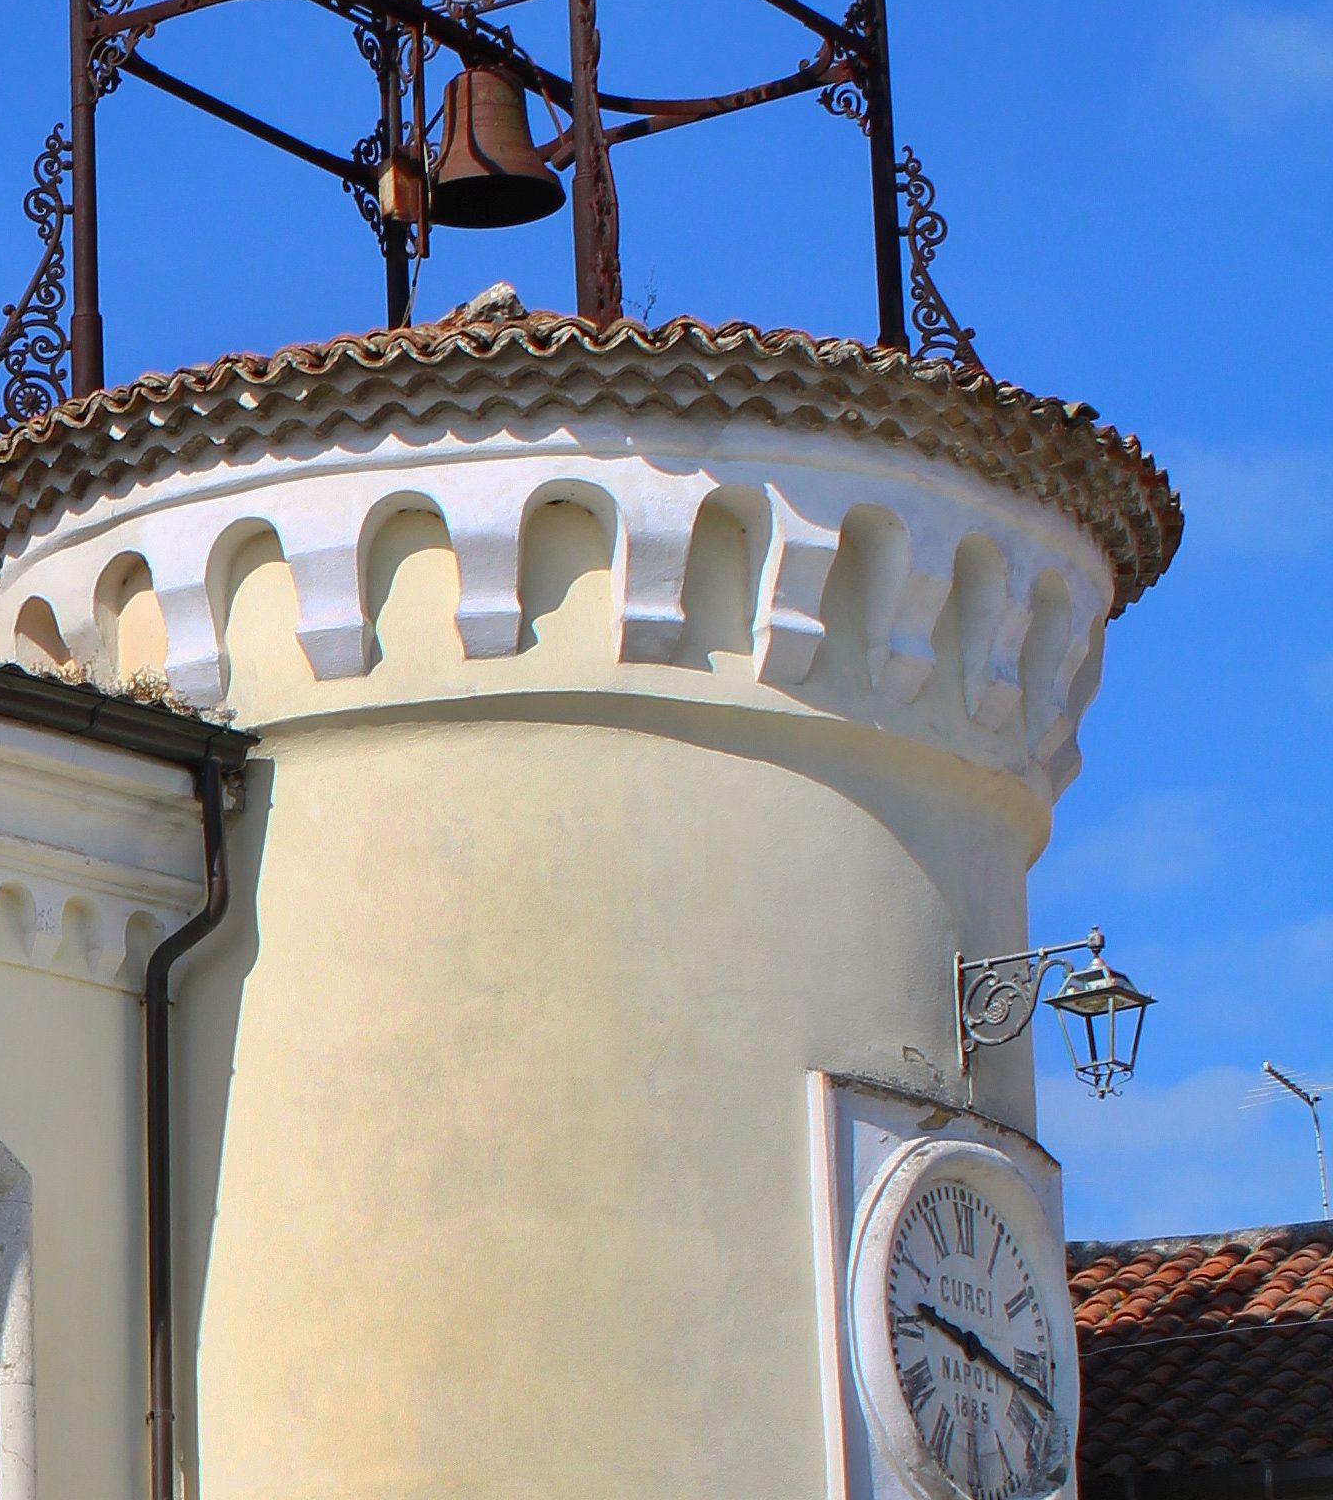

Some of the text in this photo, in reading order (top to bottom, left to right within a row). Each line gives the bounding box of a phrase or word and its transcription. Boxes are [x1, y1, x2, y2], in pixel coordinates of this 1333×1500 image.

[939, 1274, 993, 1318] CURCI
[941, 1355, 999, 1395] NAPOLI
[954, 1392, 989, 1425] 1885
